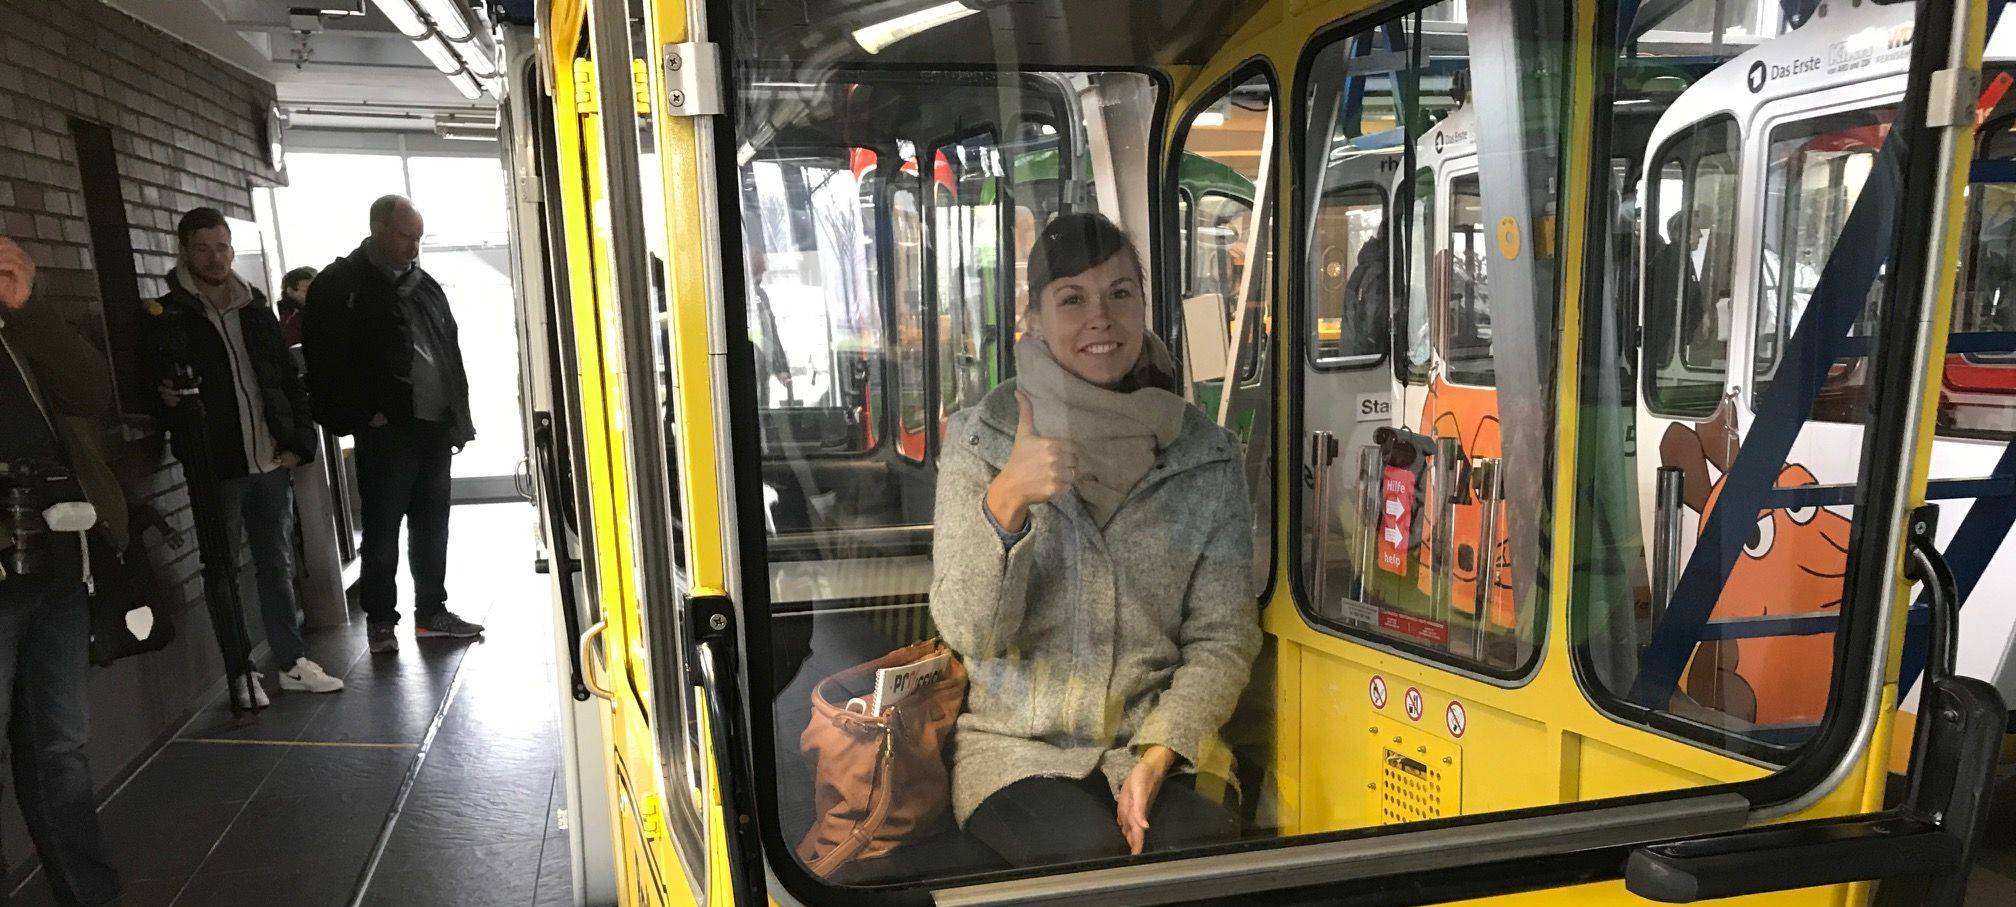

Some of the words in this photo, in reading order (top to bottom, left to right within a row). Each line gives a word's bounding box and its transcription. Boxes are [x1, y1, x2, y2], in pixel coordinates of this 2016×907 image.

[1771, 65, 1791, 80] Das
[1793, 57, 1821, 75] Erste
[1387, 480, 1405, 493] Hilfe
[1384, 552, 1400, 567] help
